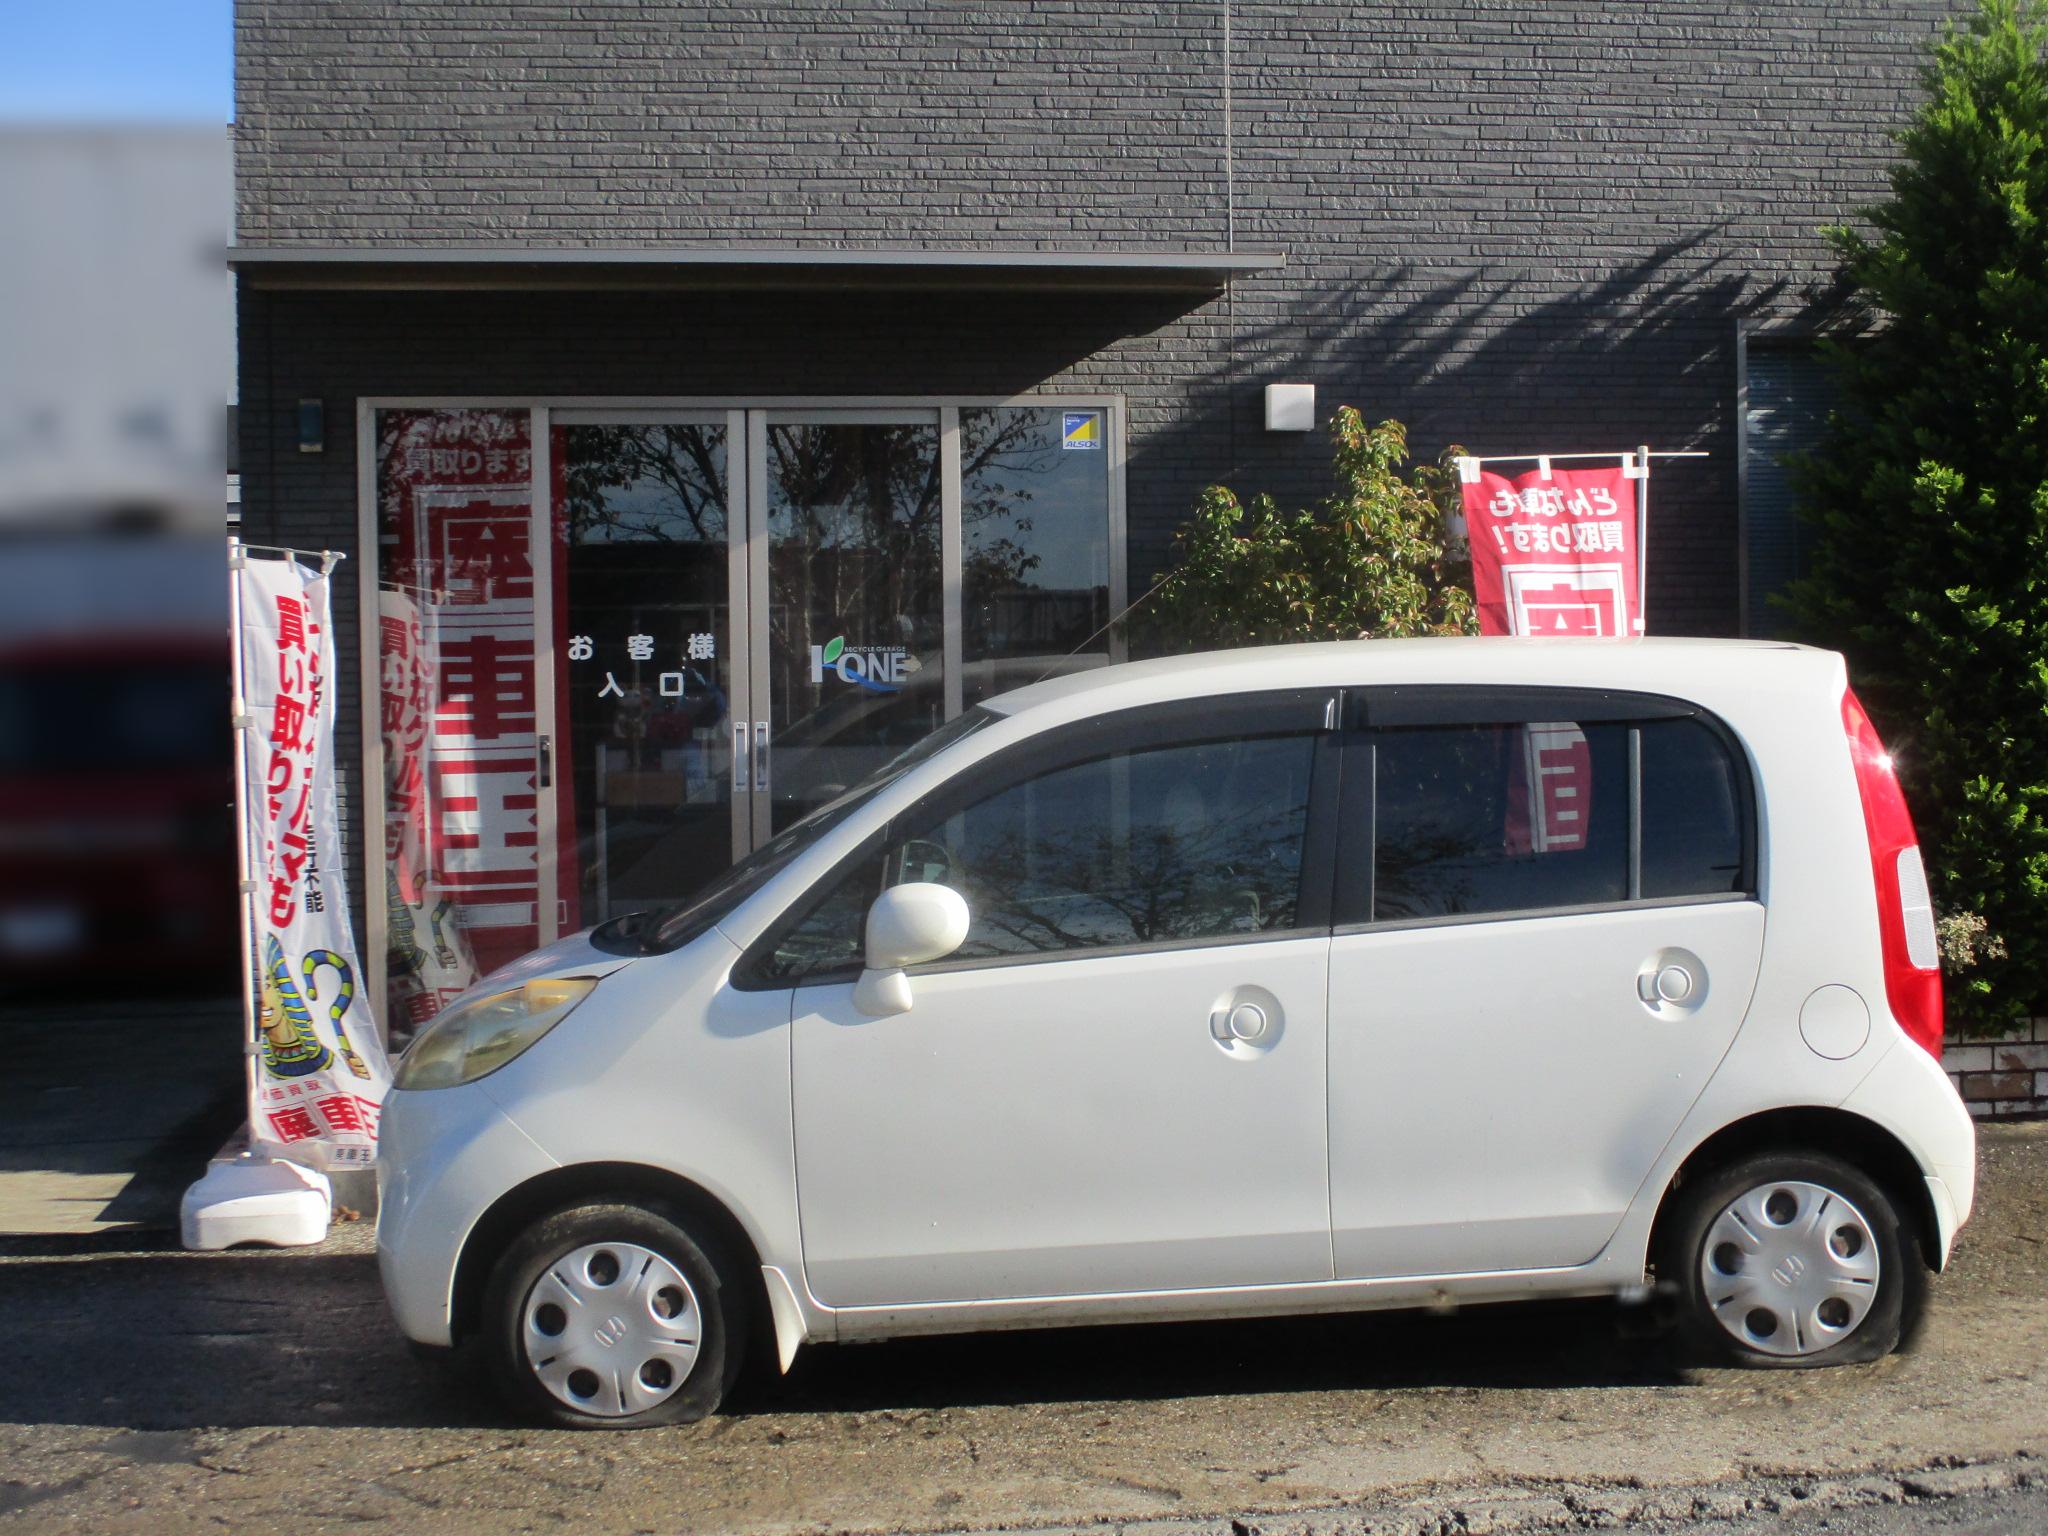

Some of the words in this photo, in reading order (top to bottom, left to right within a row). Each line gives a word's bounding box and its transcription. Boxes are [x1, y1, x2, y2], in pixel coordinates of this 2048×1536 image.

[1065, 440, 1098, 448] ALSOK
[568, 633, 715, 660] お客様
[598, 672, 684, 697] 入口
